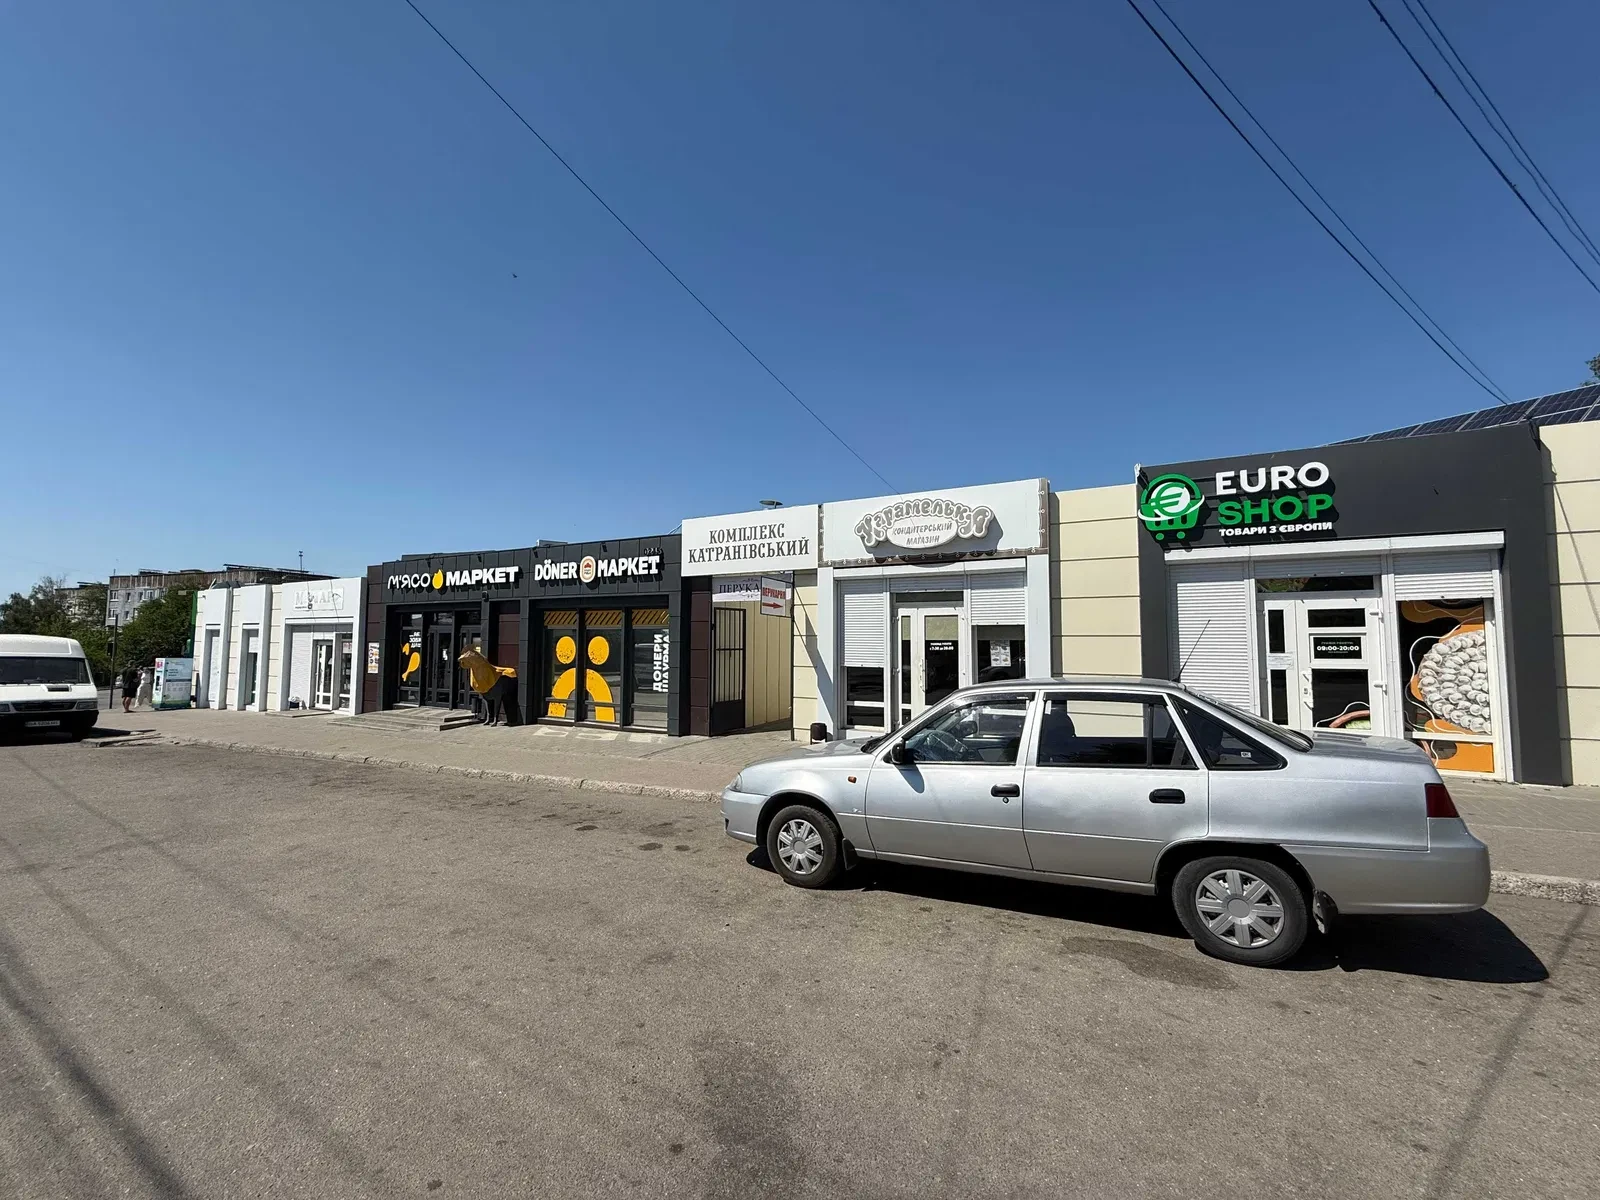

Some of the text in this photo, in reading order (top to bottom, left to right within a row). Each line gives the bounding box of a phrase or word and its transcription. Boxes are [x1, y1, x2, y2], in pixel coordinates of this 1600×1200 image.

[1216, 461, 1330, 495] EURO
[1218, 493, 1333, 525] SHOP
[709, 523, 785, 544] КОМПЛЕКС
[892, 520, 953, 536] КОНДИТЕРСЬКИЙ
[906, 535, 940, 545] МАГАЗИН
[1219, 526, 1267, 536] ТОВАРИ
[1278, 521, 1333, 533] ЄВРОПИ
[688, 537, 810, 563] КАТРАНІВСЬКИЙ
[387, 566, 519, 589] М'ЯСО МАРКЕТ
[534, 555, 660, 581] DÖNER МАРКЕТ
[653, 634, 663, 692] ДОНЕРИ
